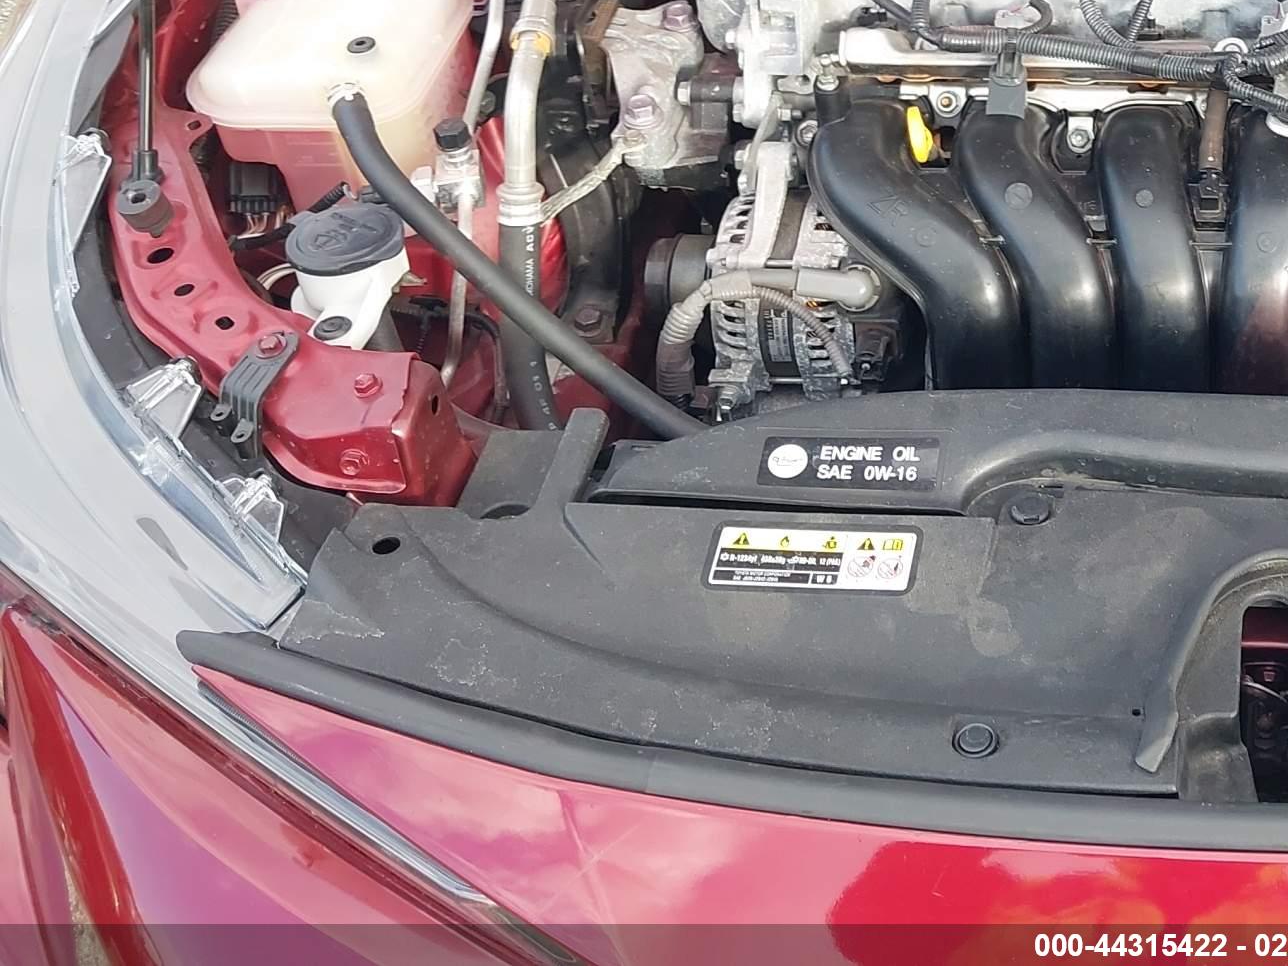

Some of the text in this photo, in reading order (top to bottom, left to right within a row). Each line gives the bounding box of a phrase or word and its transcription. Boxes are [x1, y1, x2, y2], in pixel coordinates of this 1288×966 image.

[819, 445, 921, 462] ENGINE OIL
[816, 464, 918, 481] SAE 0W-16
